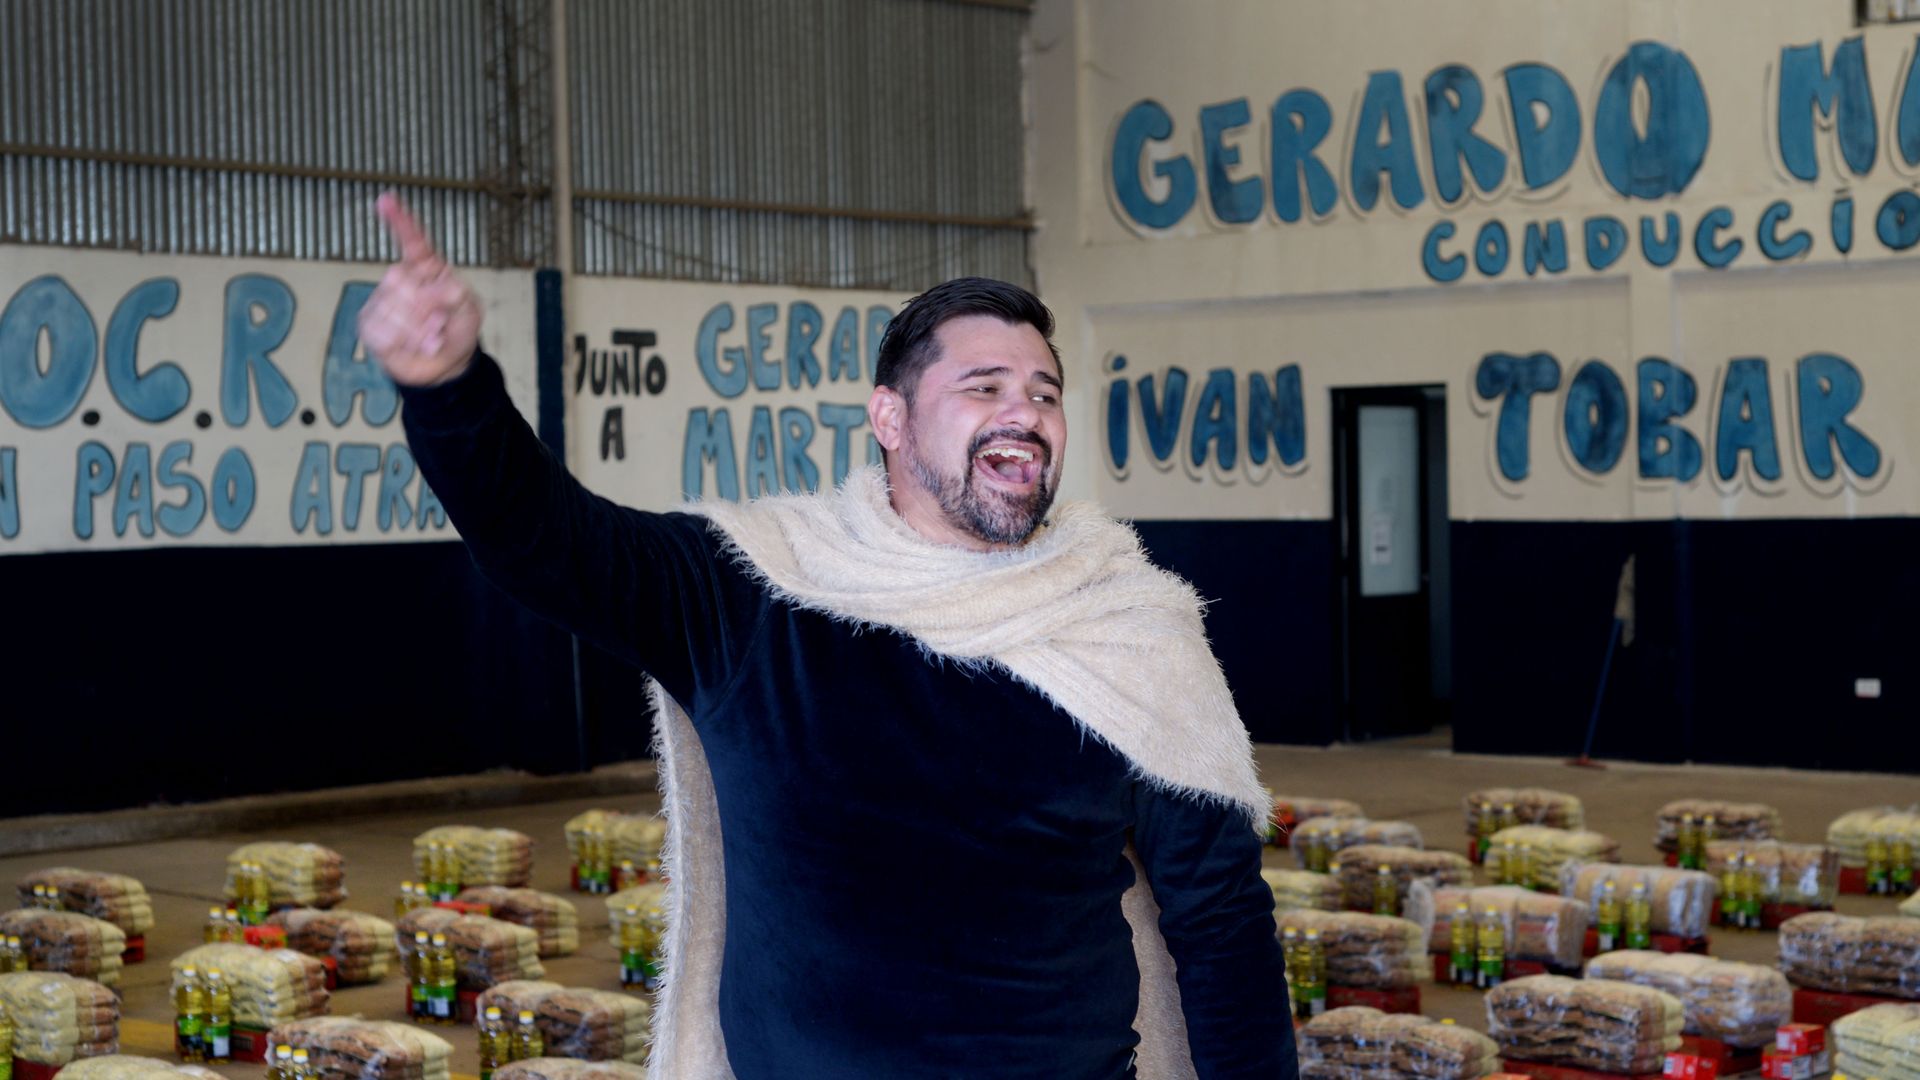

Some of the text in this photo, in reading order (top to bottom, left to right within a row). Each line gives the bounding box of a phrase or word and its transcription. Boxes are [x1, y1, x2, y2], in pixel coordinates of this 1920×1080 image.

[1111, 40, 1710, 231] GERARDO
[573, 329, 667, 397] JUNTO
[599, 405, 626, 462] A
[1476, 351, 1881, 482] TOBAR
[73, 440, 257, 541] PASO
